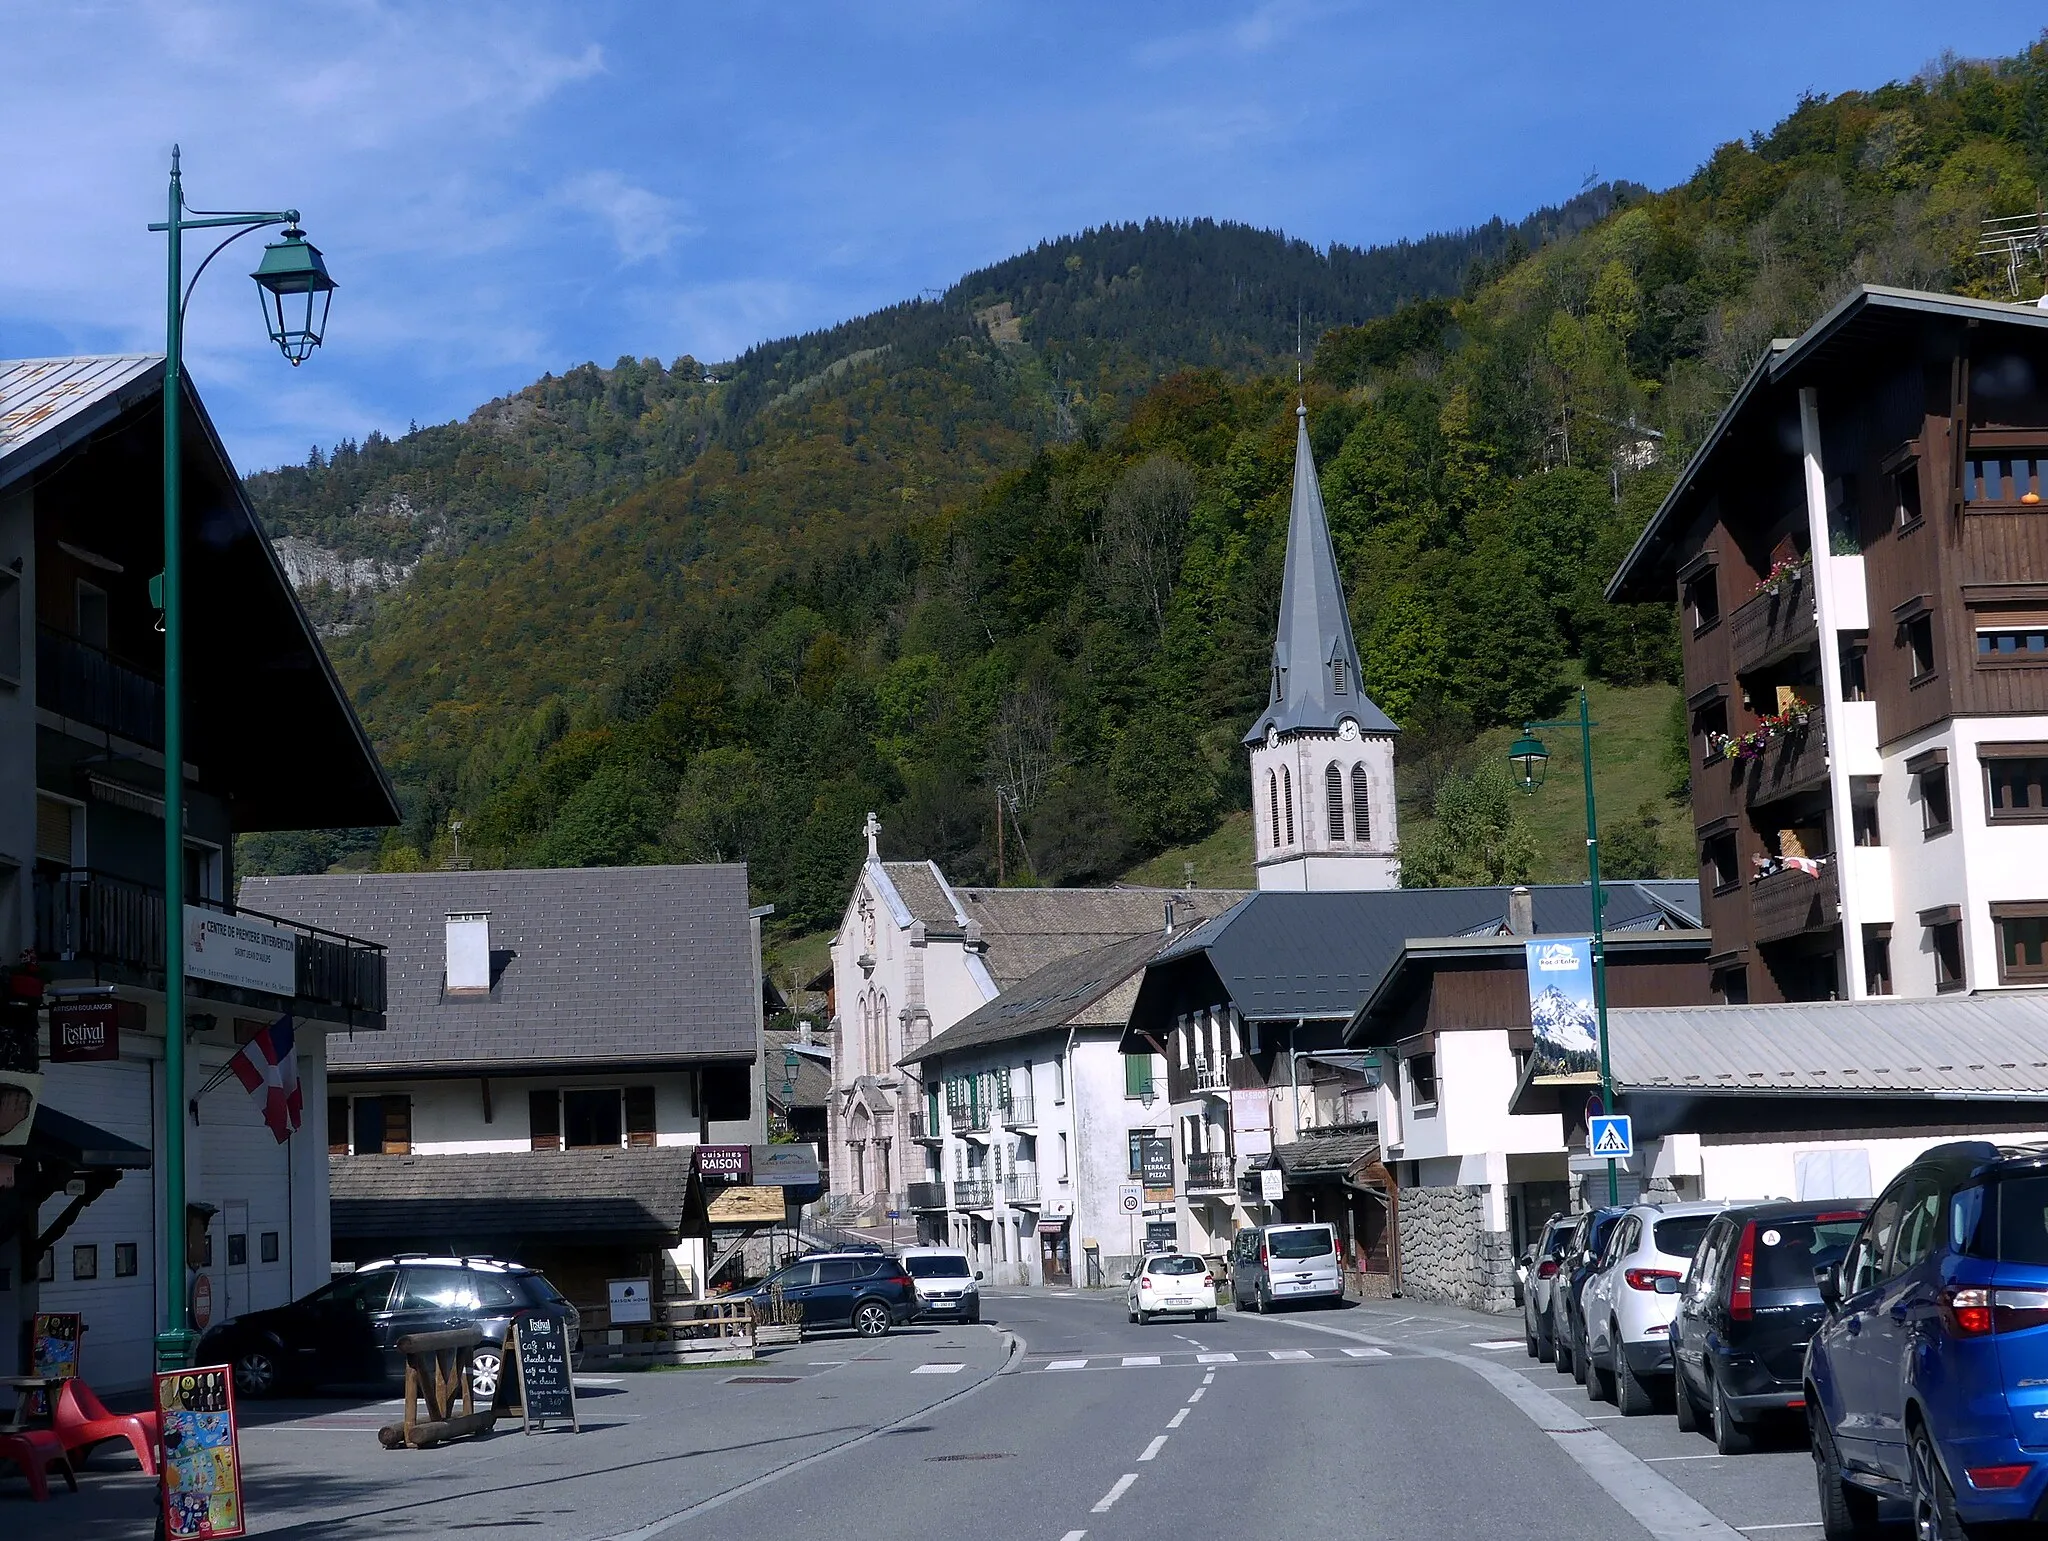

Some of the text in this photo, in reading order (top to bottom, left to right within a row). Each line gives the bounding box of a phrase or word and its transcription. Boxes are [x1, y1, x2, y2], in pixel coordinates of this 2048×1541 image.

[206, 920, 227, 937] CENTRE
[227, 925, 235, 938] DE
[261, 933, 294, 952] INTERVENTION
[53, 1003, 113, 1012] ARTISAN BOULANGER
[62, 1021, 104, 1045] Festival
[701, 1150, 742, 1158] cuisines
[701, 1159, 742, 1169] RAISON
[1126, 1199, 1136, 1207] 30
[1767, 1232, 1776, 1243] A
